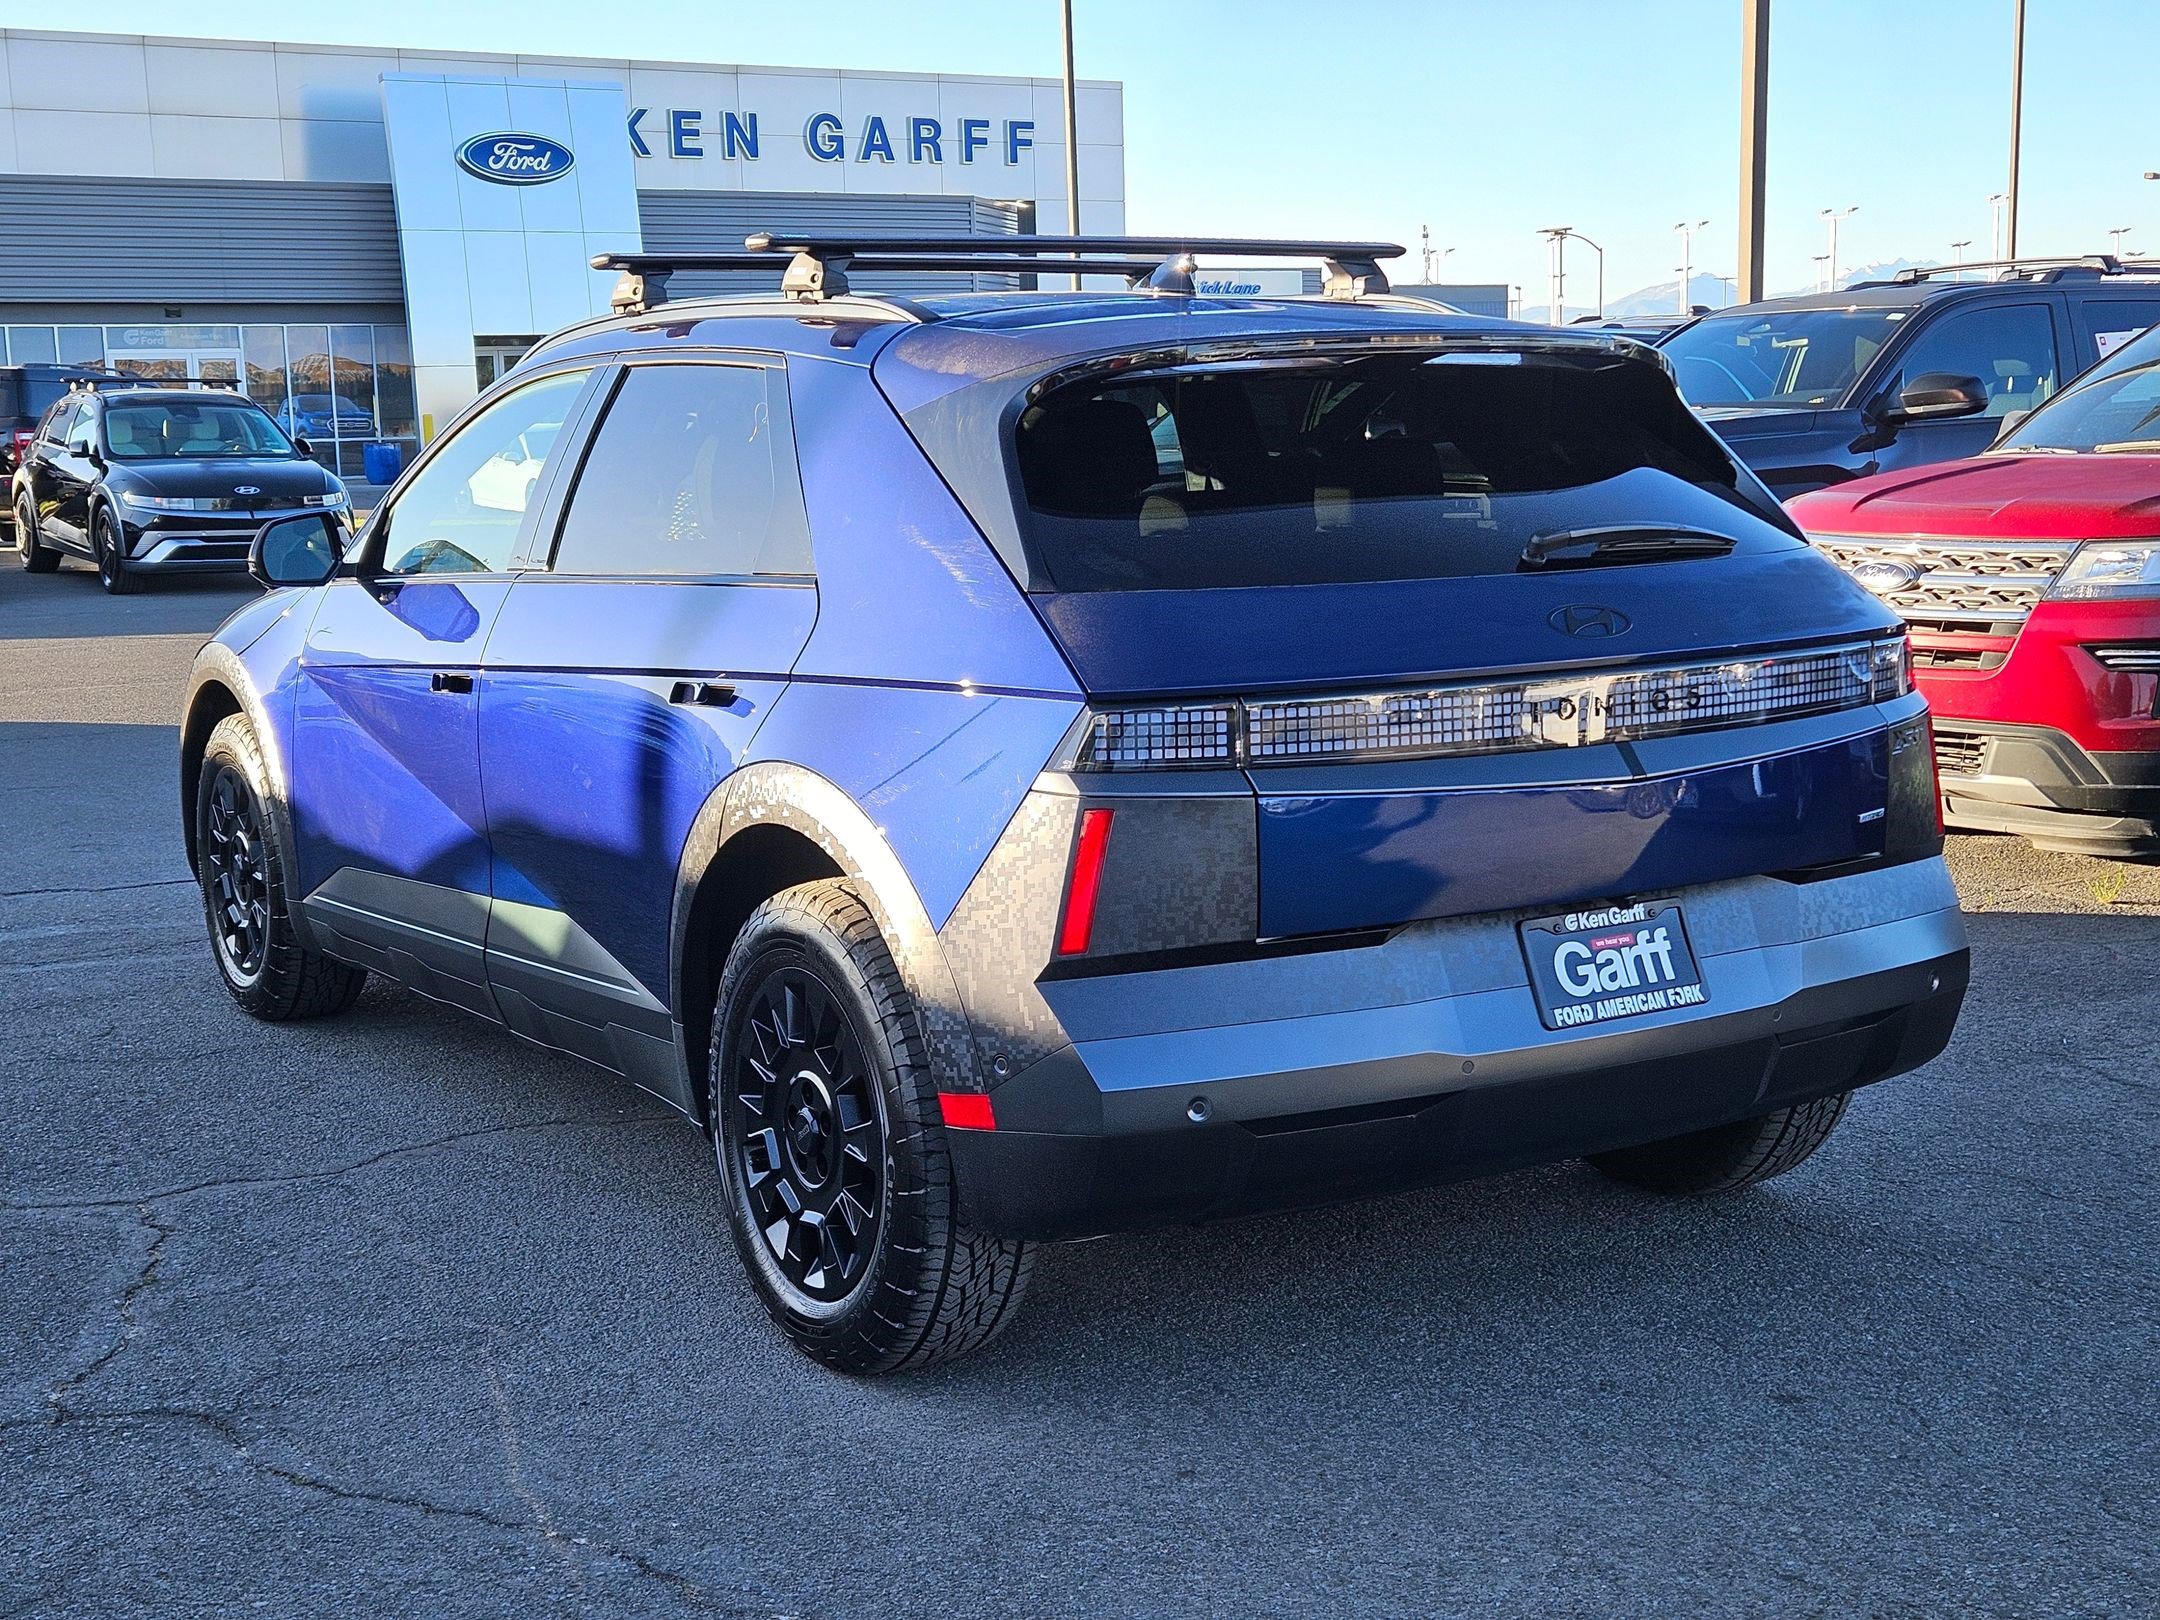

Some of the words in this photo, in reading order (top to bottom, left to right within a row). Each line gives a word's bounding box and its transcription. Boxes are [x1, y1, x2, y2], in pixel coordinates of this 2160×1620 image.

[626, 107, 760, 160] KEN
[804, 111, 1035, 166] GARFF
[488, 142, 551, 171] Ford
[1197, 280, 1223, 294] ick
[1223, 280, 1262, 295] Lane
[141, 336, 164, 345] Ford
[1618, 936, 1630, 945] you
[1553, 927, 1676, 998] Garff
[1554, 1003, 1594, 1027] FORD
[1597, 990, 1667, 1020] AMERICAN
[1667, 984, 1705, 1007] FORK
